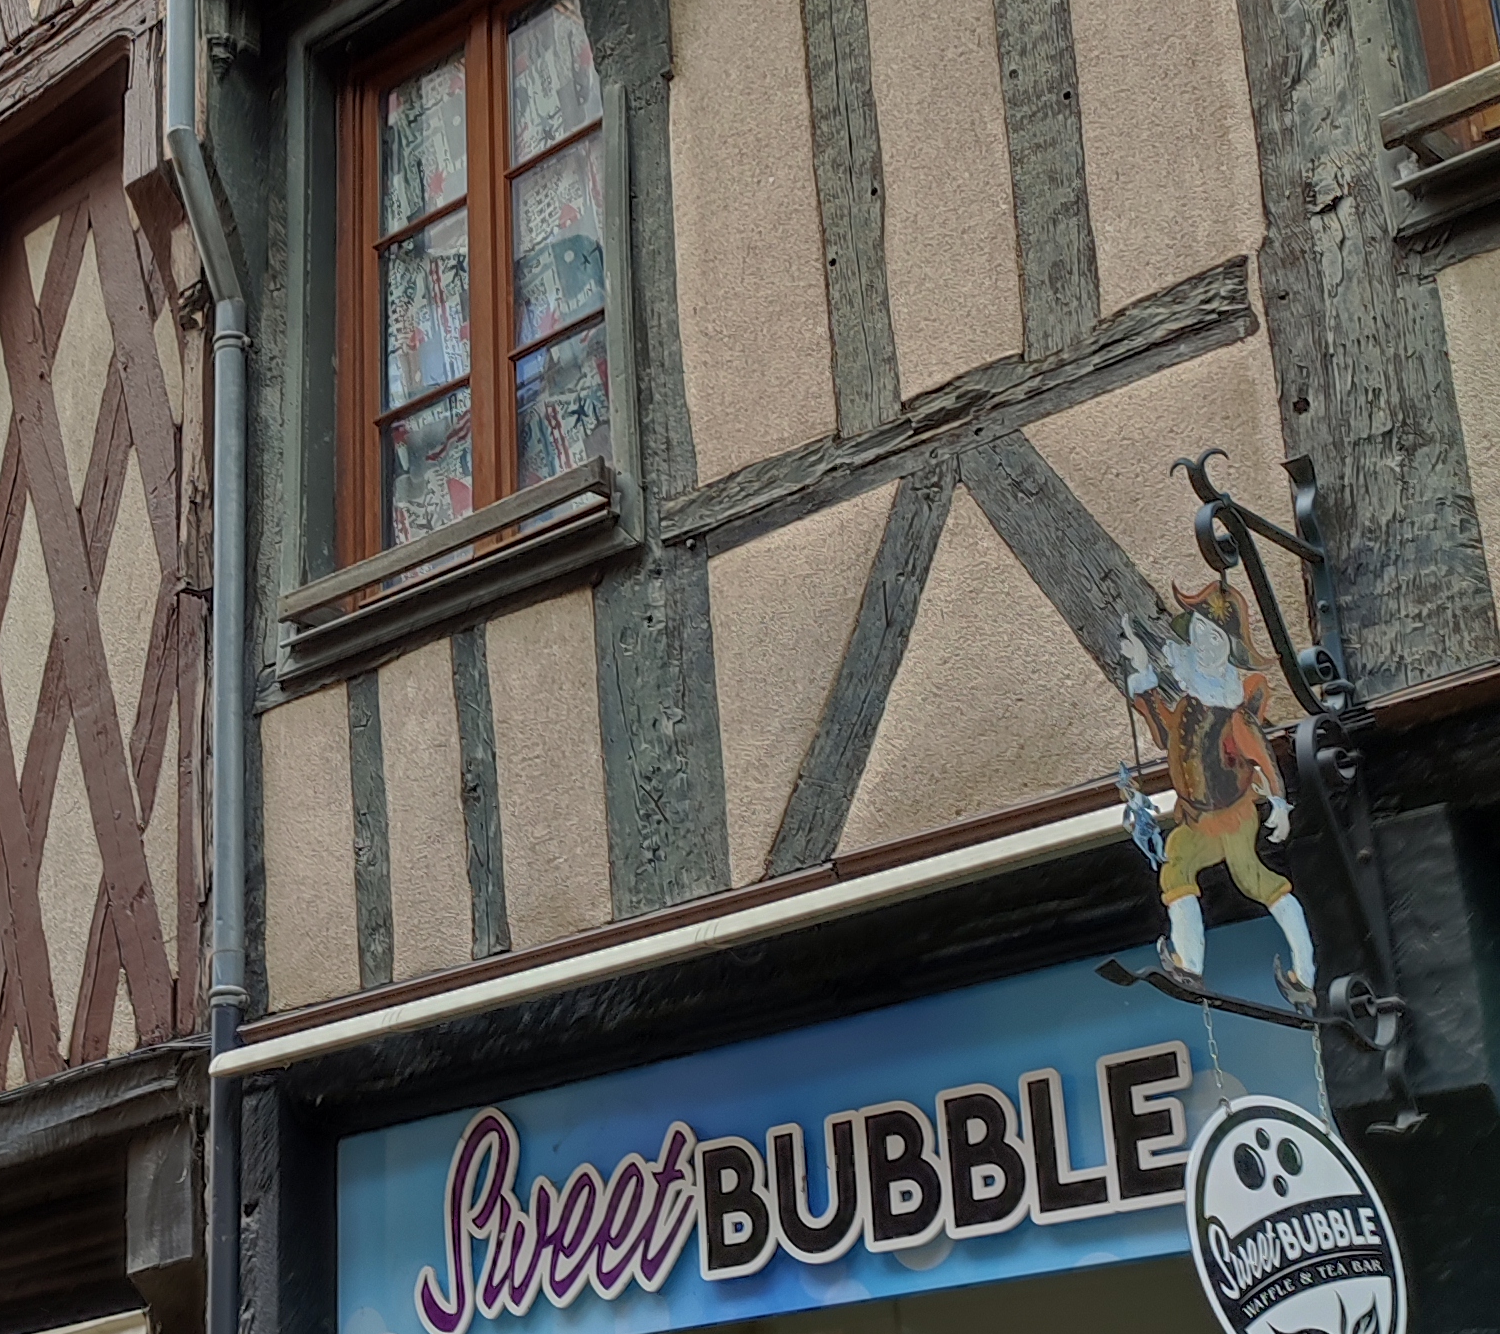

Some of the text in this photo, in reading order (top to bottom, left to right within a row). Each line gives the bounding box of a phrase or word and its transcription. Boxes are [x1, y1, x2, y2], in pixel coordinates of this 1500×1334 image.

[699, 1043, 1190, 1279] BUBBLE
[1208, 1206, 1382, 1301] Sweet BUBBLE
[1241, 1257, 1385, 1319] WAFFLE & TEA BAR
